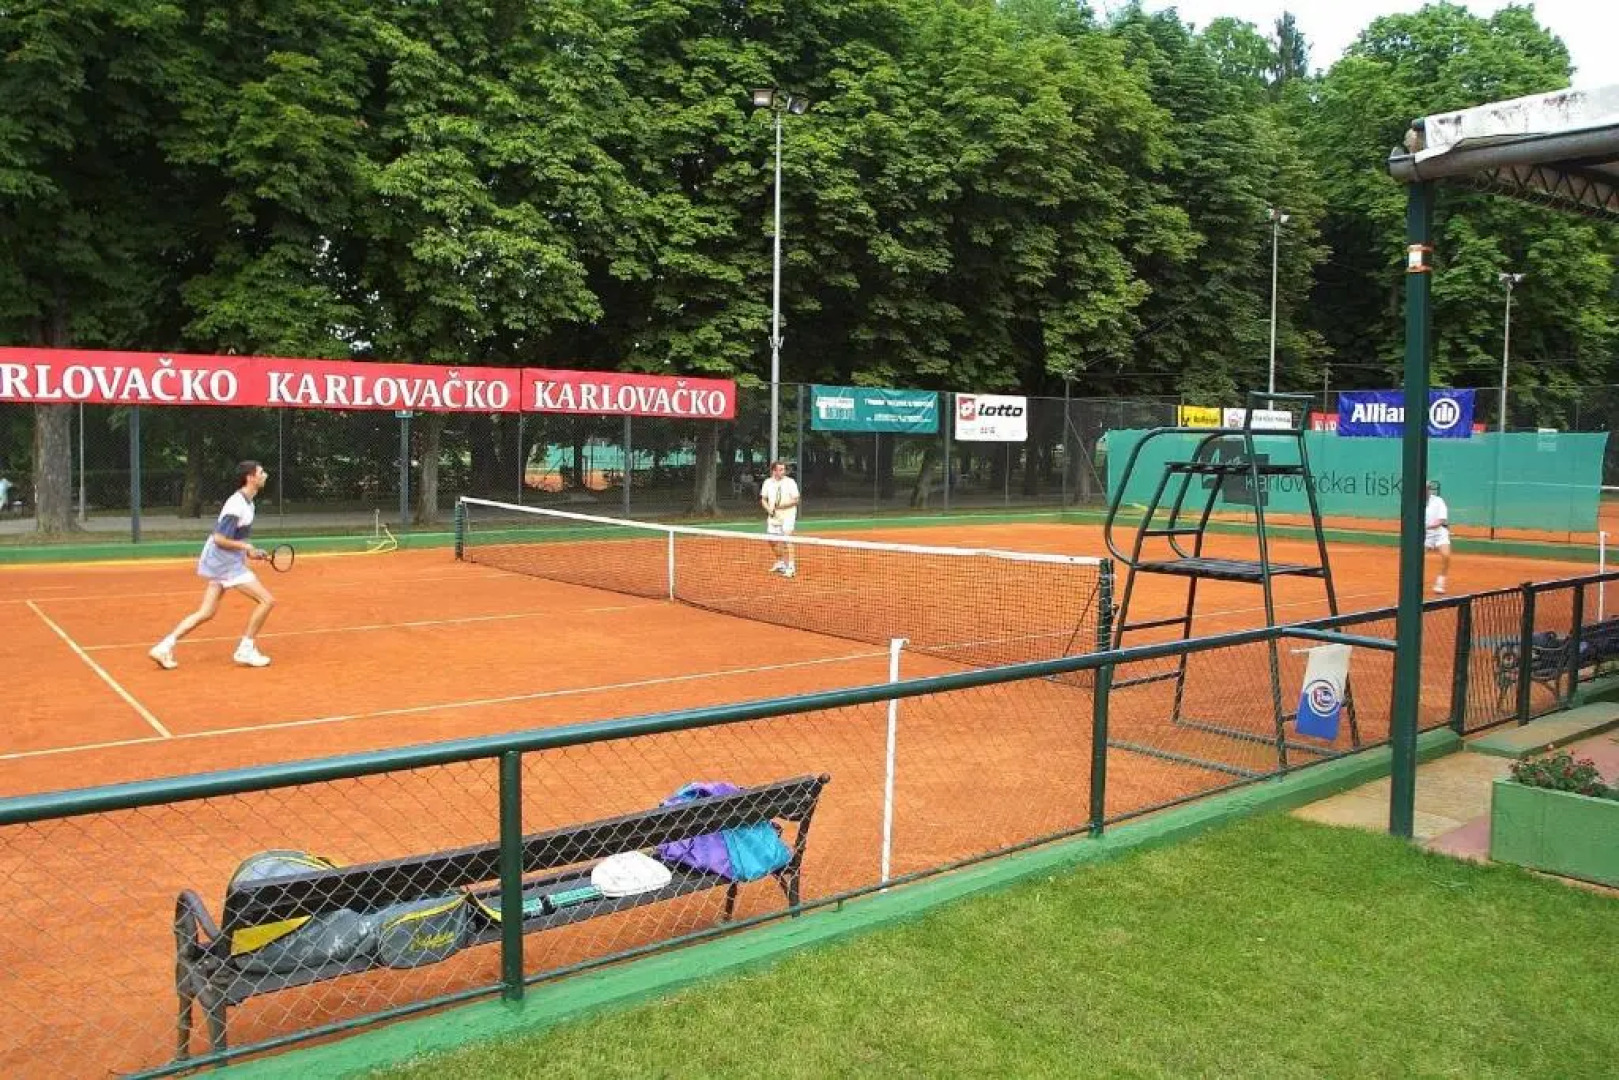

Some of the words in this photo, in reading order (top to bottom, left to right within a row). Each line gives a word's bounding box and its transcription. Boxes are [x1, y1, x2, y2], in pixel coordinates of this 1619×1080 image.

[267, 370, 511, 409] KARLOVAČKO
[534, 380, 726, 415] KARLOVAČKO
[1351, 403, 1405, 423] Allia
